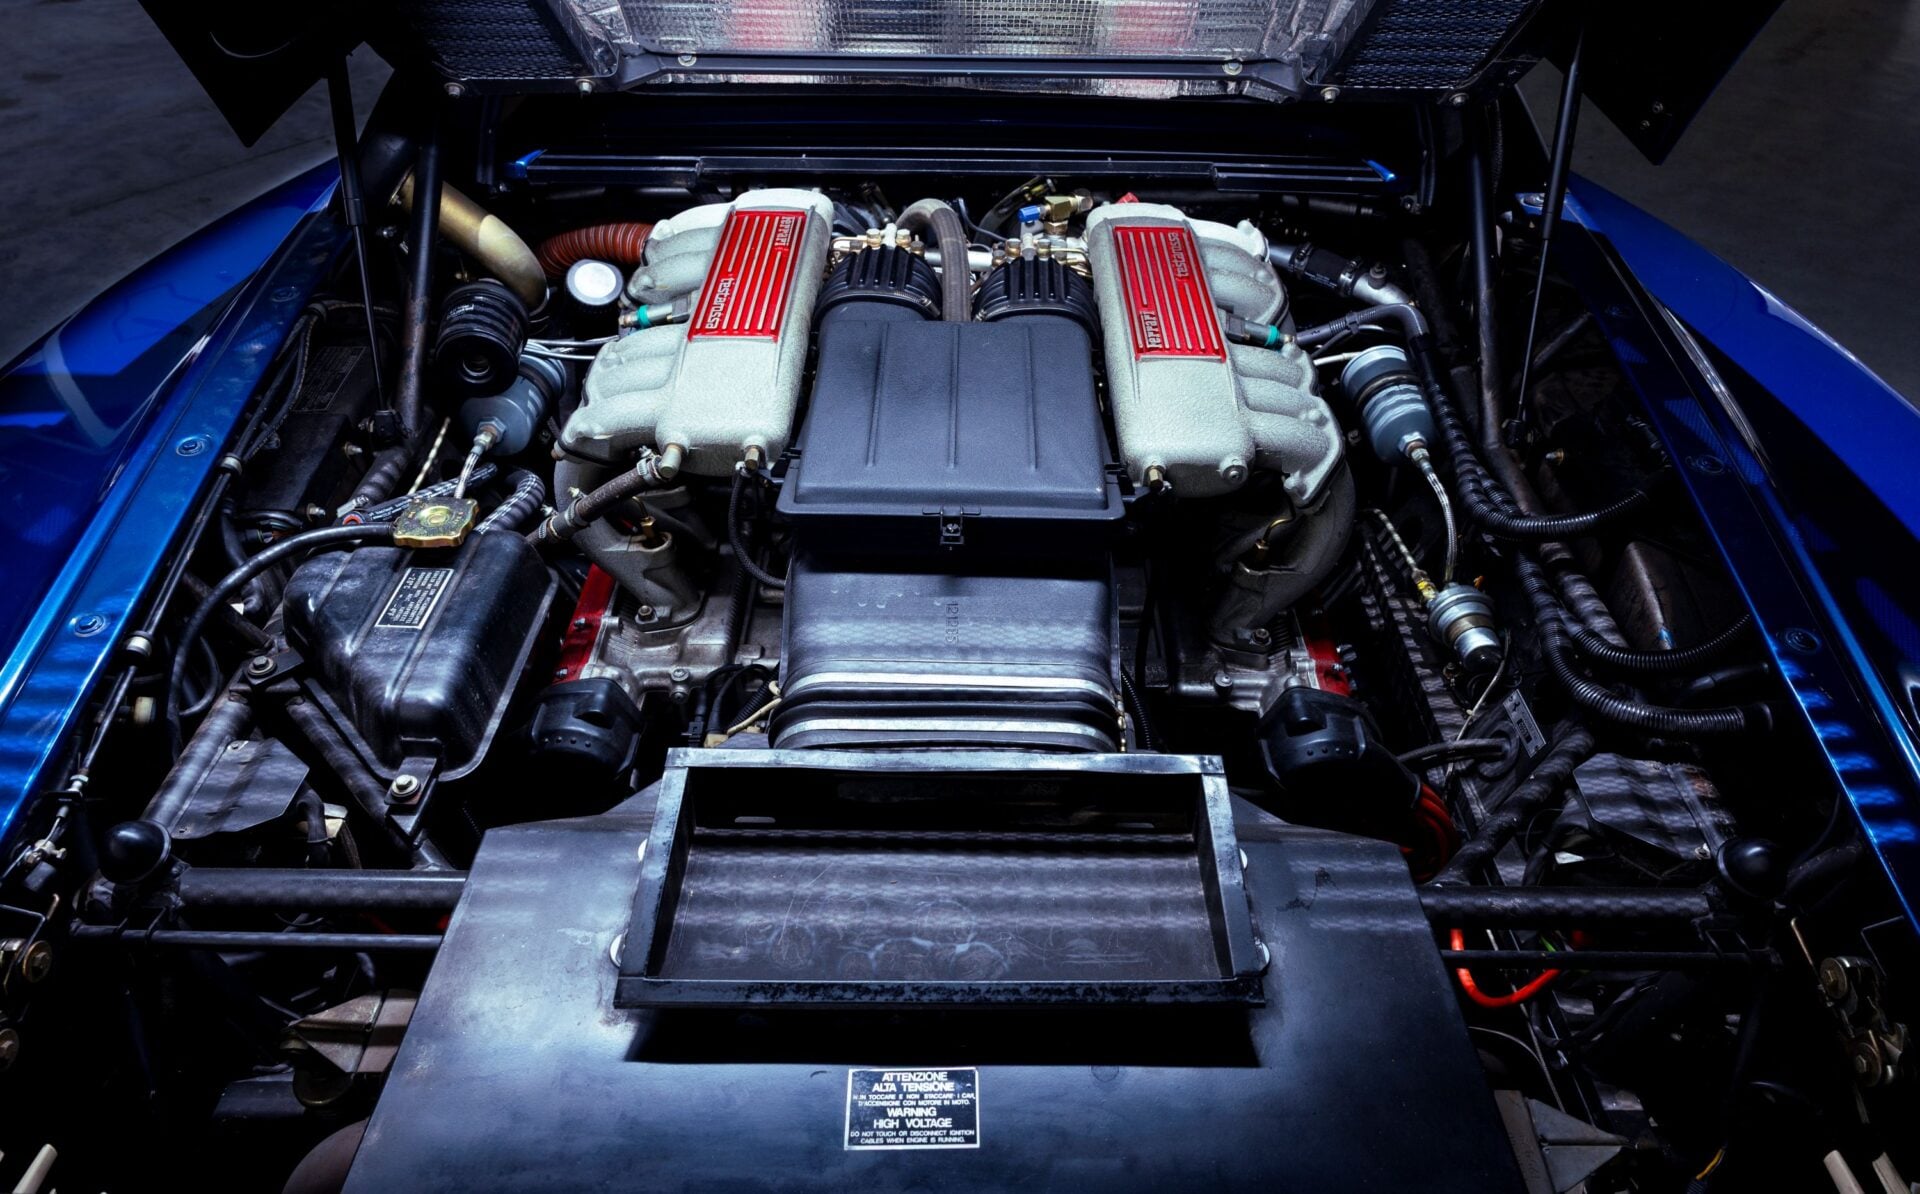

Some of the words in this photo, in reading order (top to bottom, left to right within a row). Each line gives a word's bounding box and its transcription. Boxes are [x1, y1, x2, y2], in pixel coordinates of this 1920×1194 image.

[774, 216, 795, 247] Ferrari
[705, 278, 734, 329] testarossa
[1140, 310, 1163, 349] Ferrari
[882, 1072, 948, 1082] ATTENZIONE
[872, 1083, 897, 1092] ALTA
[901, 1082, 955, 1092] TENSIONE
[887, 1107, 937, 1117] WARNING
[873, 1119, 899, 1128] HIGH
[905, 1118, 952, 1128] VOLTAGE
